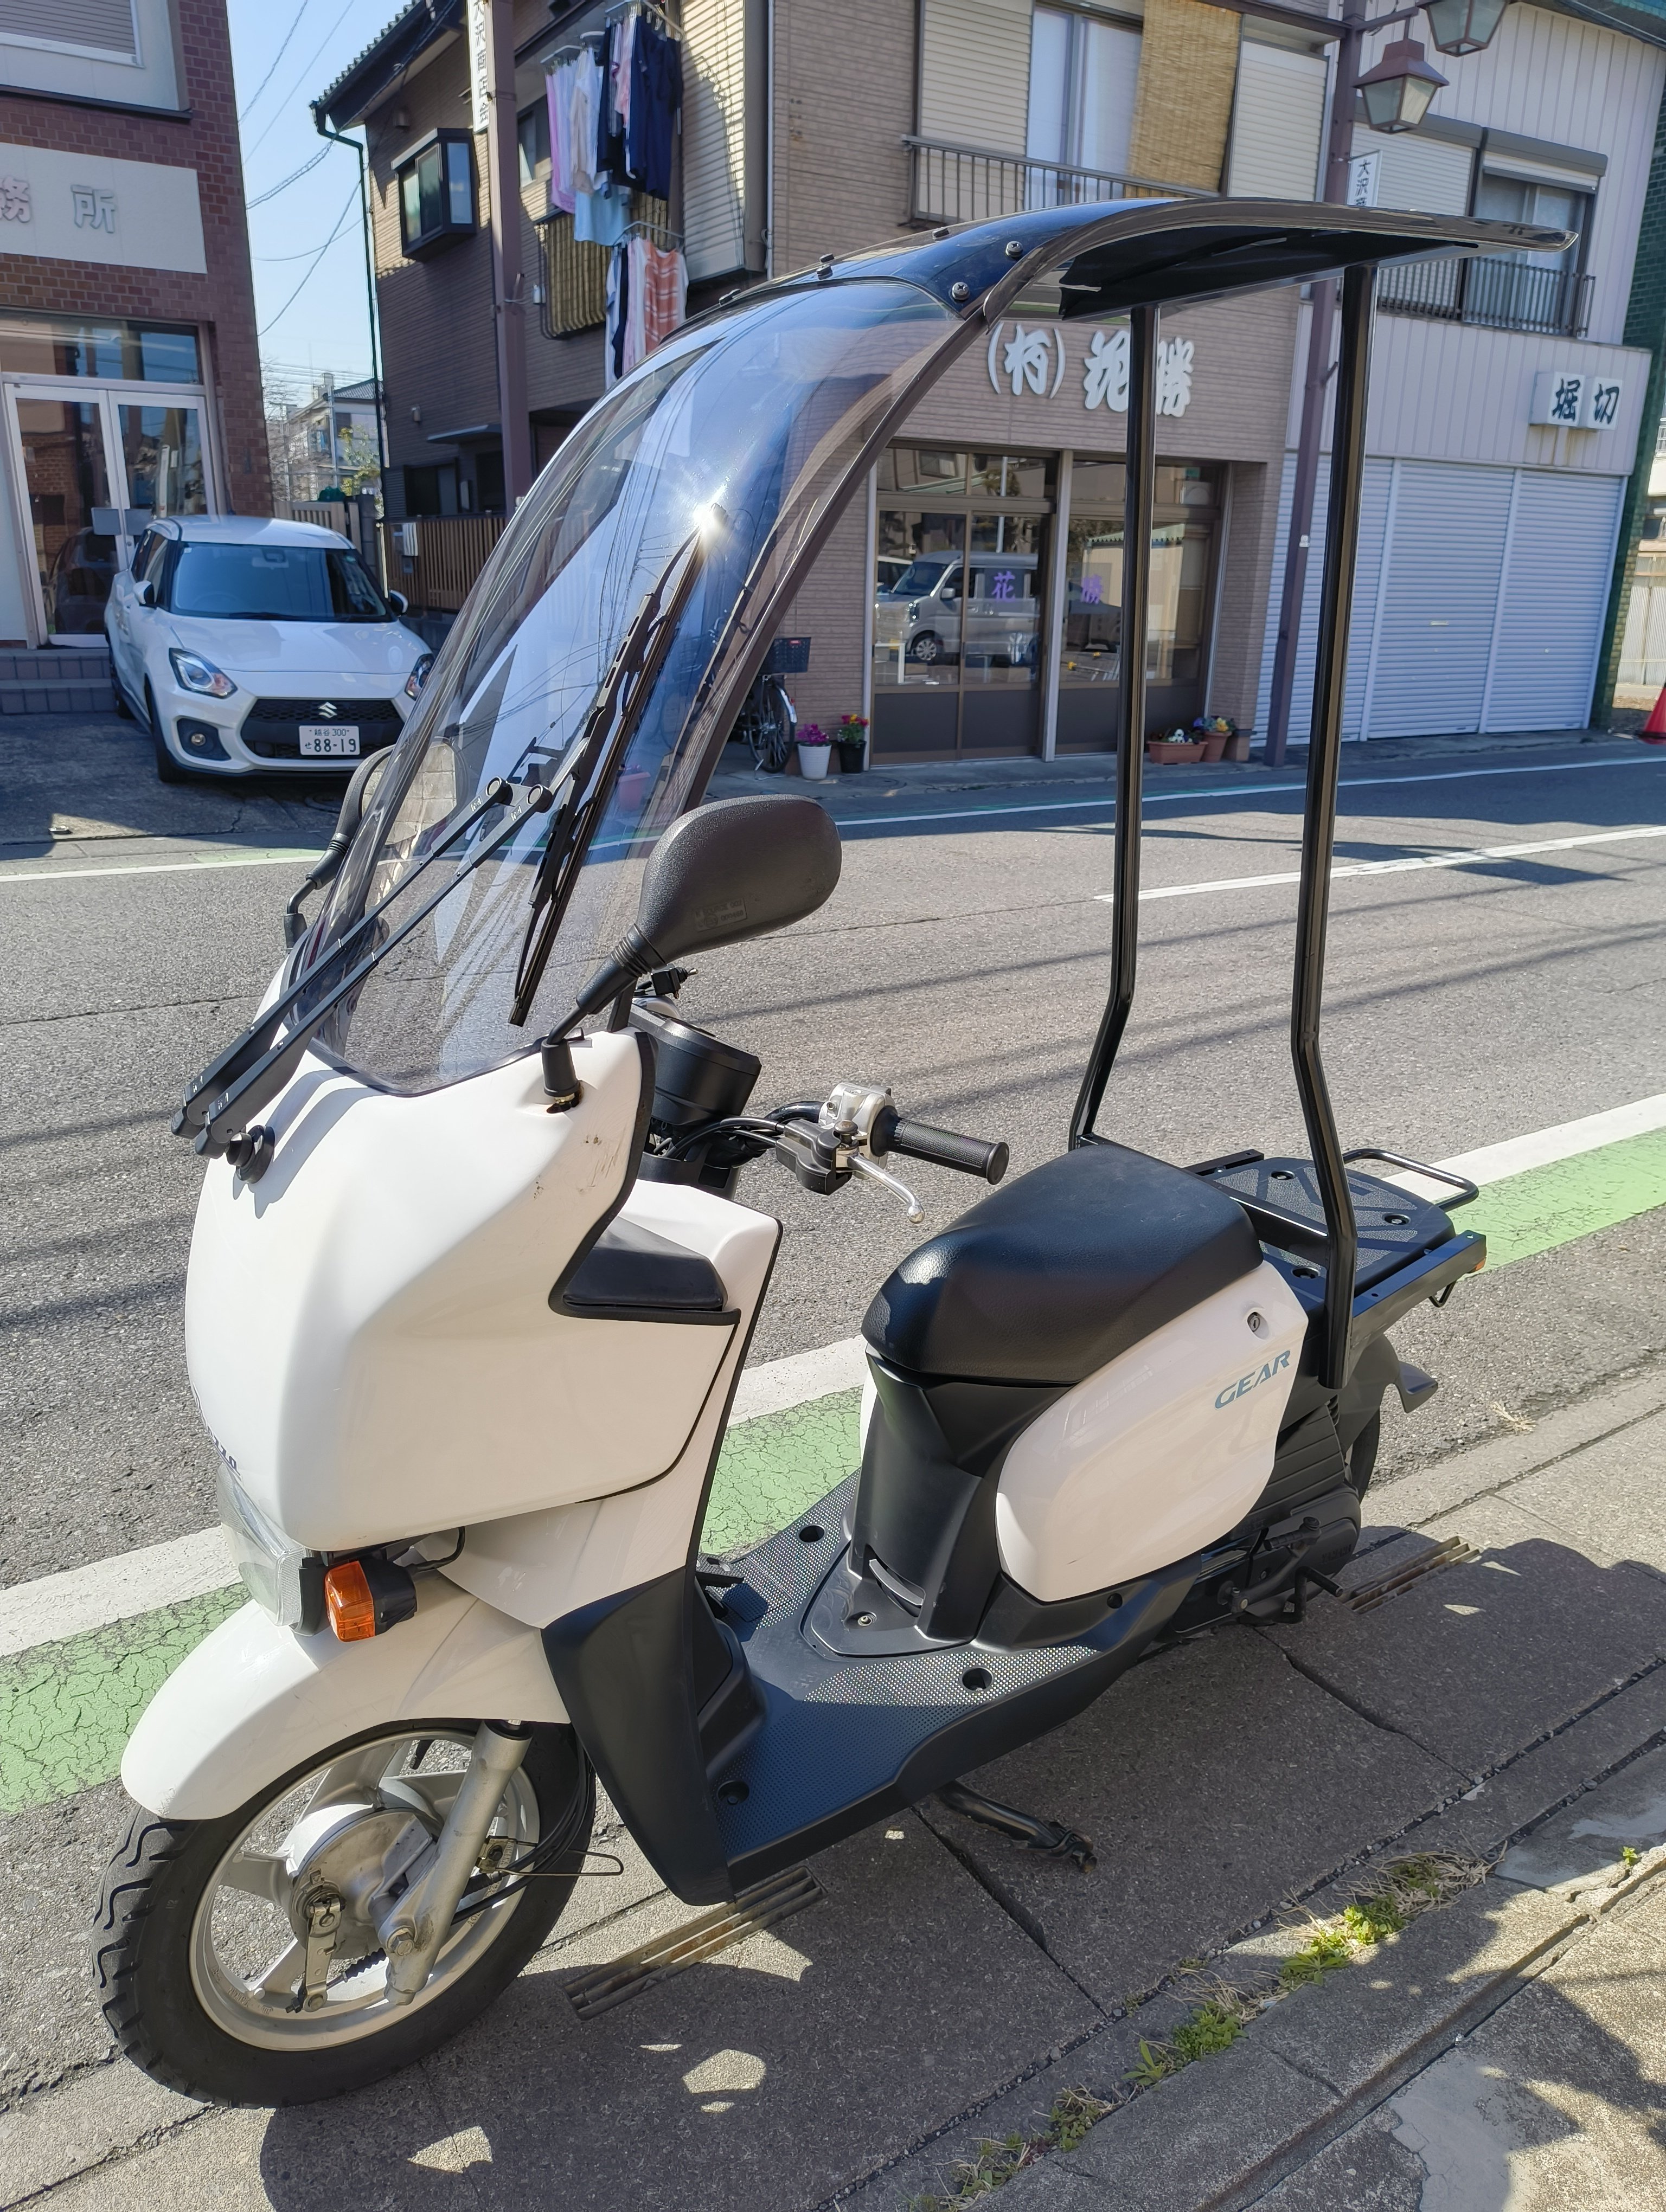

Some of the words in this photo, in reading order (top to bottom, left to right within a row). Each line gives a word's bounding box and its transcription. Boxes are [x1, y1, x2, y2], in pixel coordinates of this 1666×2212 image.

[1552, 377, 1620, 425] 堀切
[991, 570, 1016, 603] 花
[314, 738, 356, 753] 88-19
[332, 729, 347, 737] 300
[1214, 1349, 1291, 1410] GEAR
